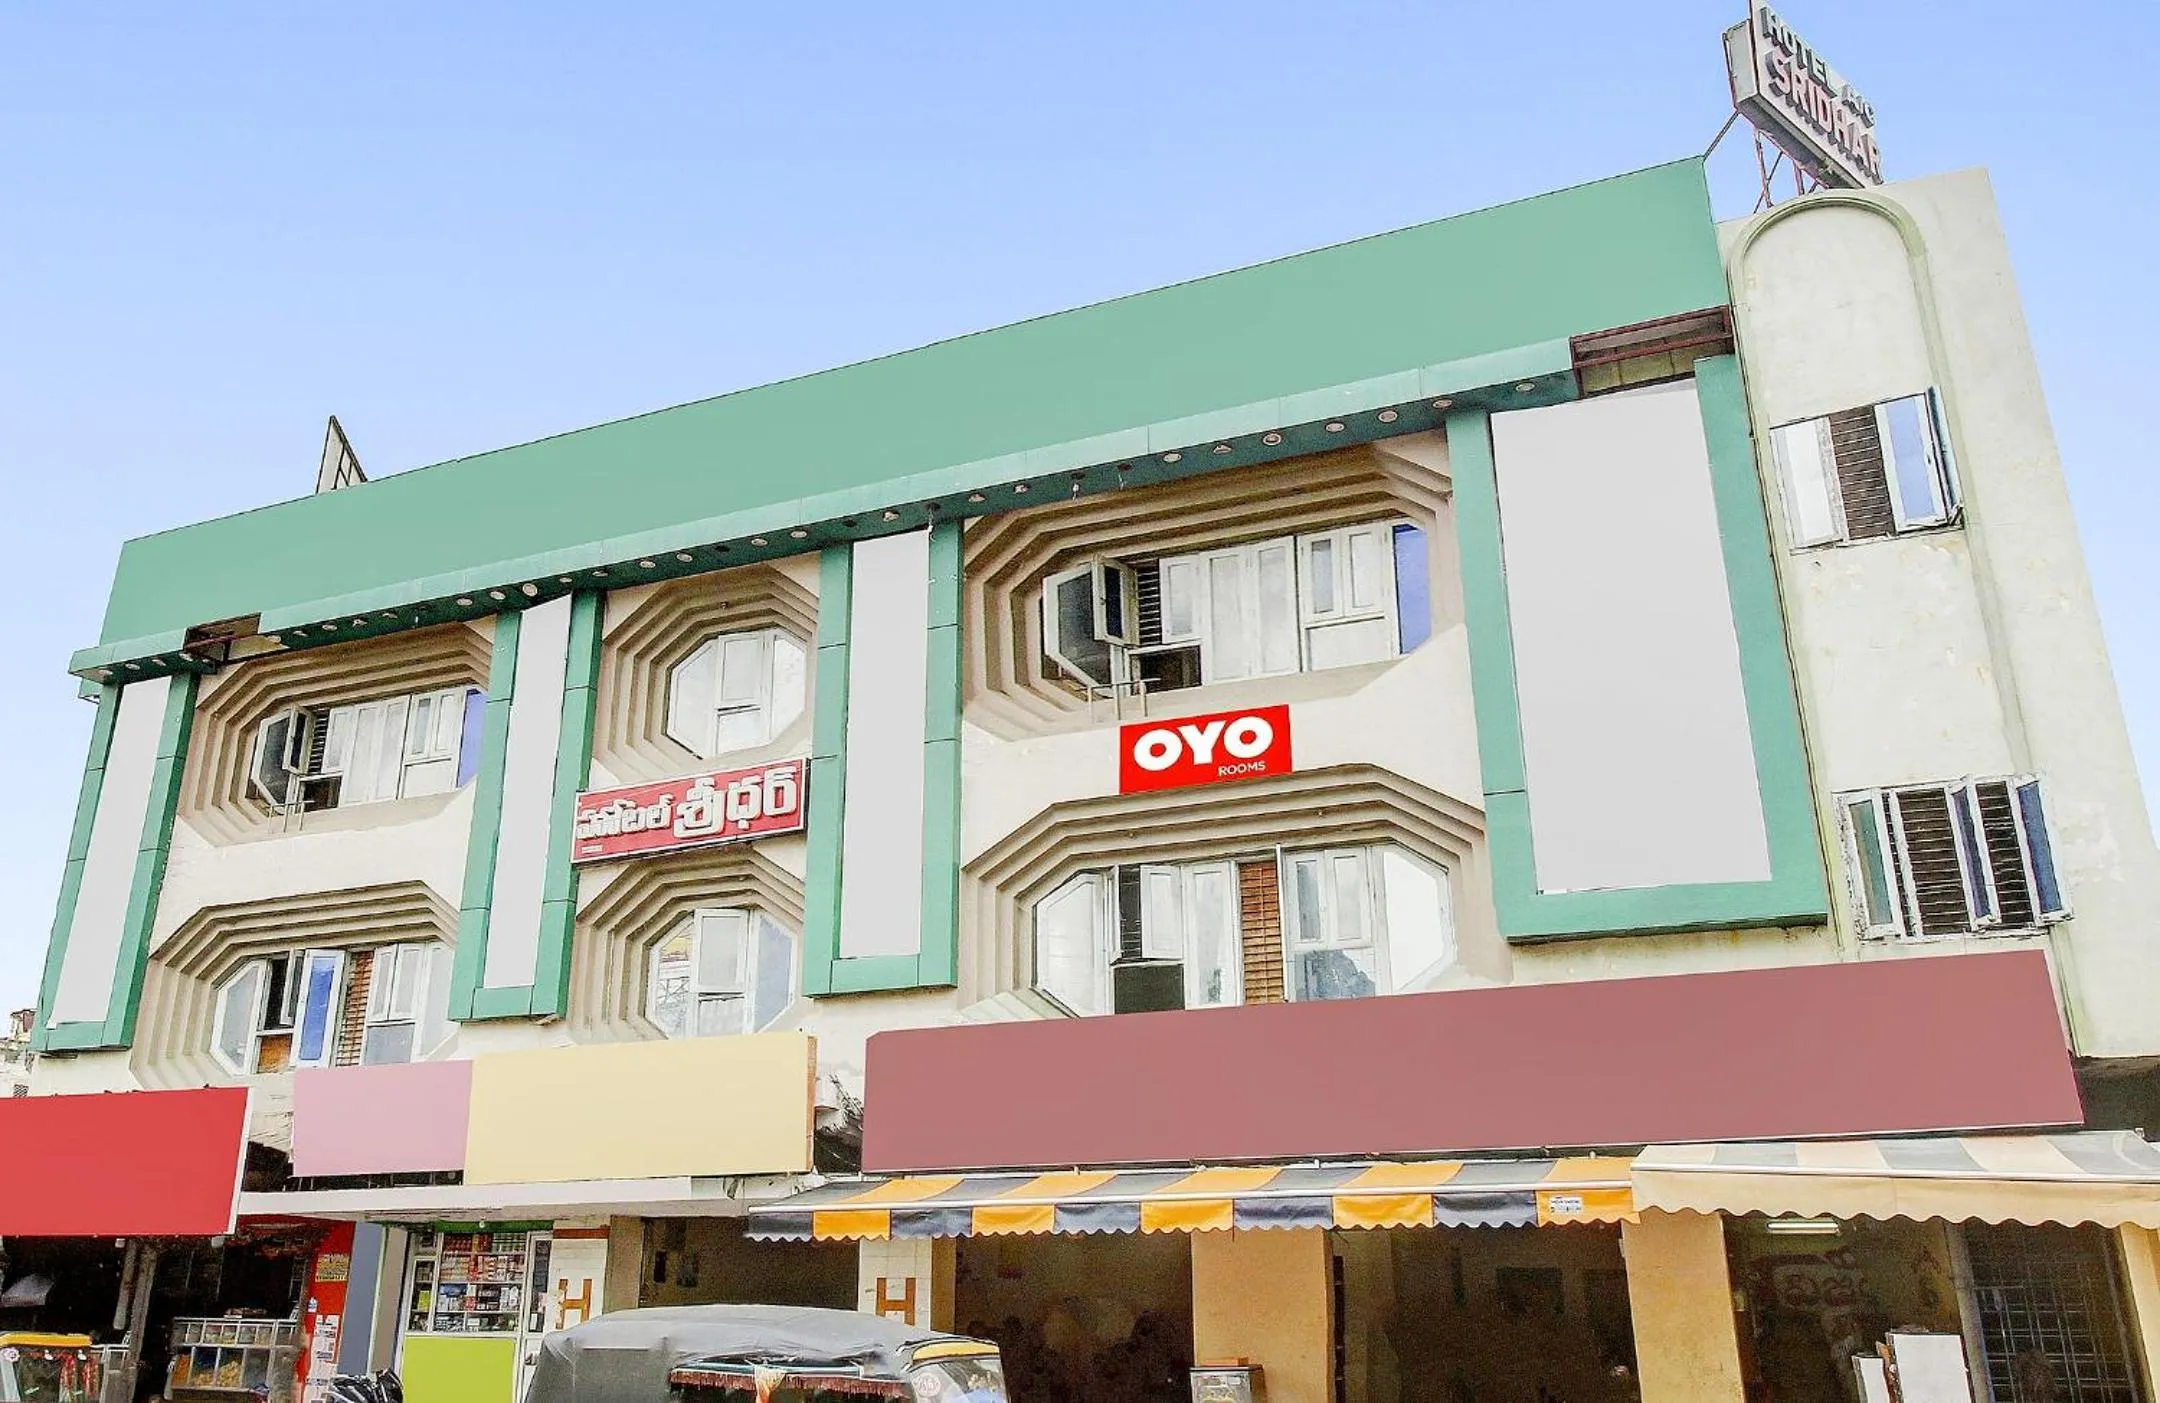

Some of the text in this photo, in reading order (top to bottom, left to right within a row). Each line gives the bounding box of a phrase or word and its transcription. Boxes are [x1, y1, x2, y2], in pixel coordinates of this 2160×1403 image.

[1760, 6, 1838, 98] HOTEL
[1765, 52, 1883, 184] SRIDHAR
[1133, 716, 1273, 771] OYO
[1218, 760, 1266, 777] ROOMS
[674, 766, 797, 838] శ్రీధర్
